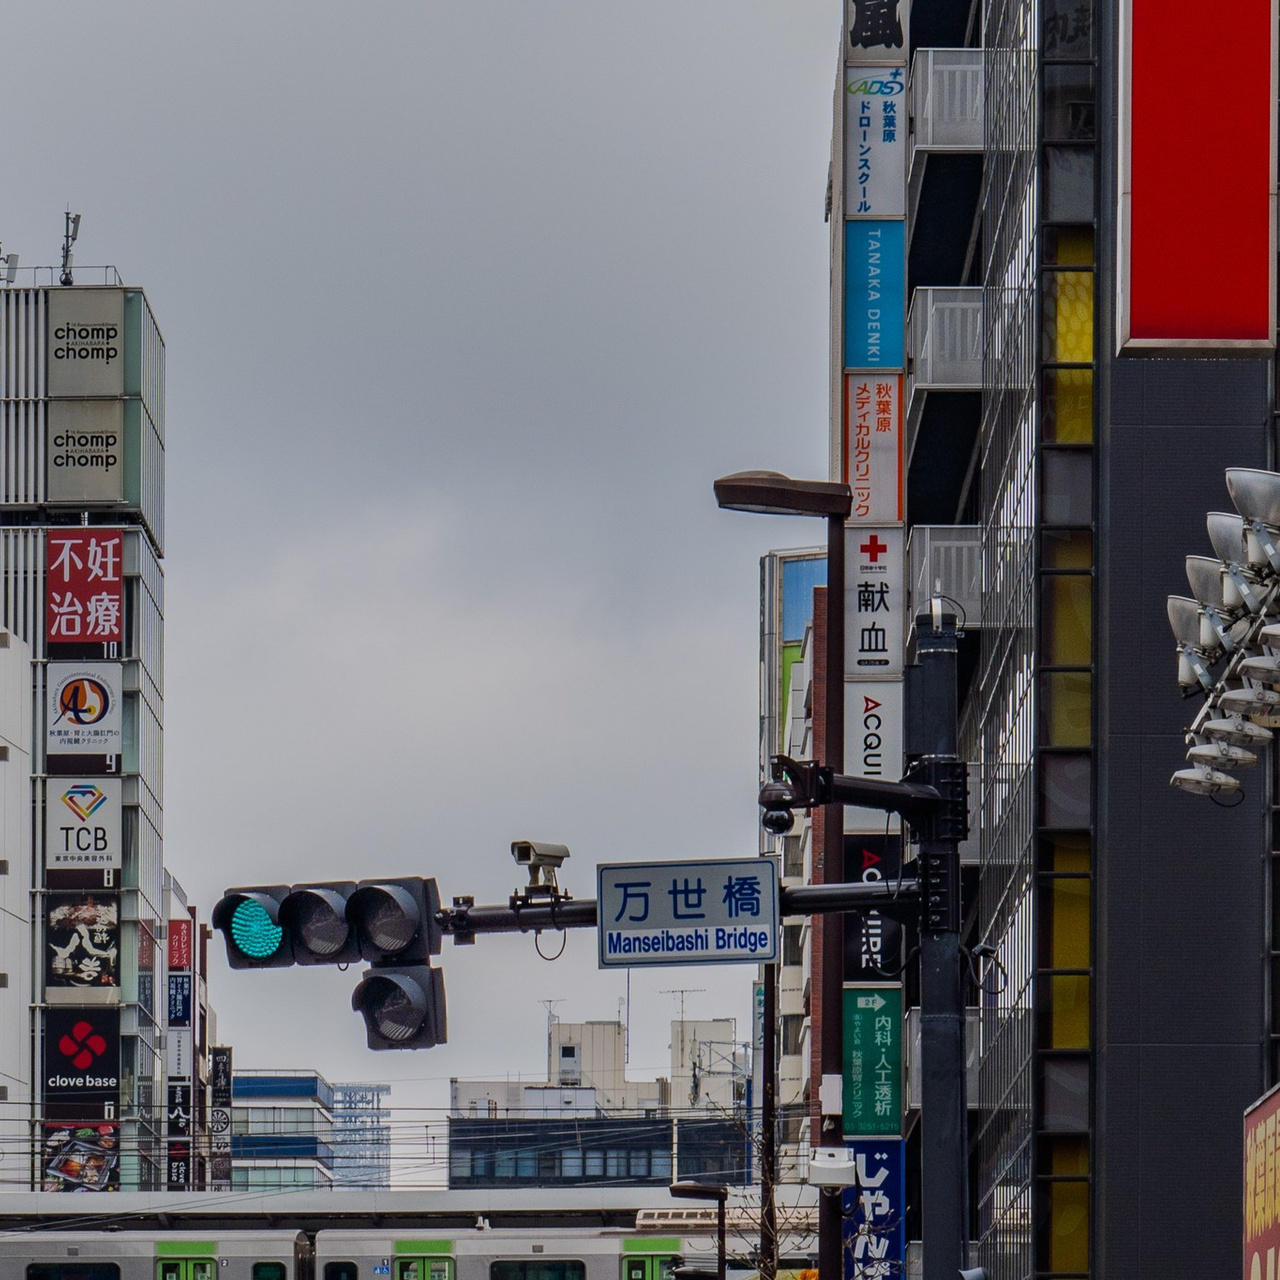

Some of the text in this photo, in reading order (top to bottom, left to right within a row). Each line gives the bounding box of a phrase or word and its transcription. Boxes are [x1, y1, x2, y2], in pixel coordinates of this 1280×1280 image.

[882, 101, 896, 143] 秋葉原
[857, 101, 871, 213] ドローンスクール
[868, 229, 881, 362] TANAKA DENKI
[54, 322, 118, 345] chomp
[54, 342, 118, 365] chomp
[875, 383, 892, 433] 秋葉原
[53, 429, 117, 452] chomp
[53, 449, 117, 472] chomp
[855, 383, 871, 517] メディカルクリニック
[50, 538, 120, 582] 不妊
[50, 592, 120, 636] 治療
[857, 581, 890, 652] 献血
[60, 826, 108, 852] TCB
[613, 875, 761, 923] 万世橋
[608, 926, 768, 954] Manseibashi Bridge
[48, 1075, 117, 1087] clove base
[875, 1015, 892, 1116] 内科・人工透析
